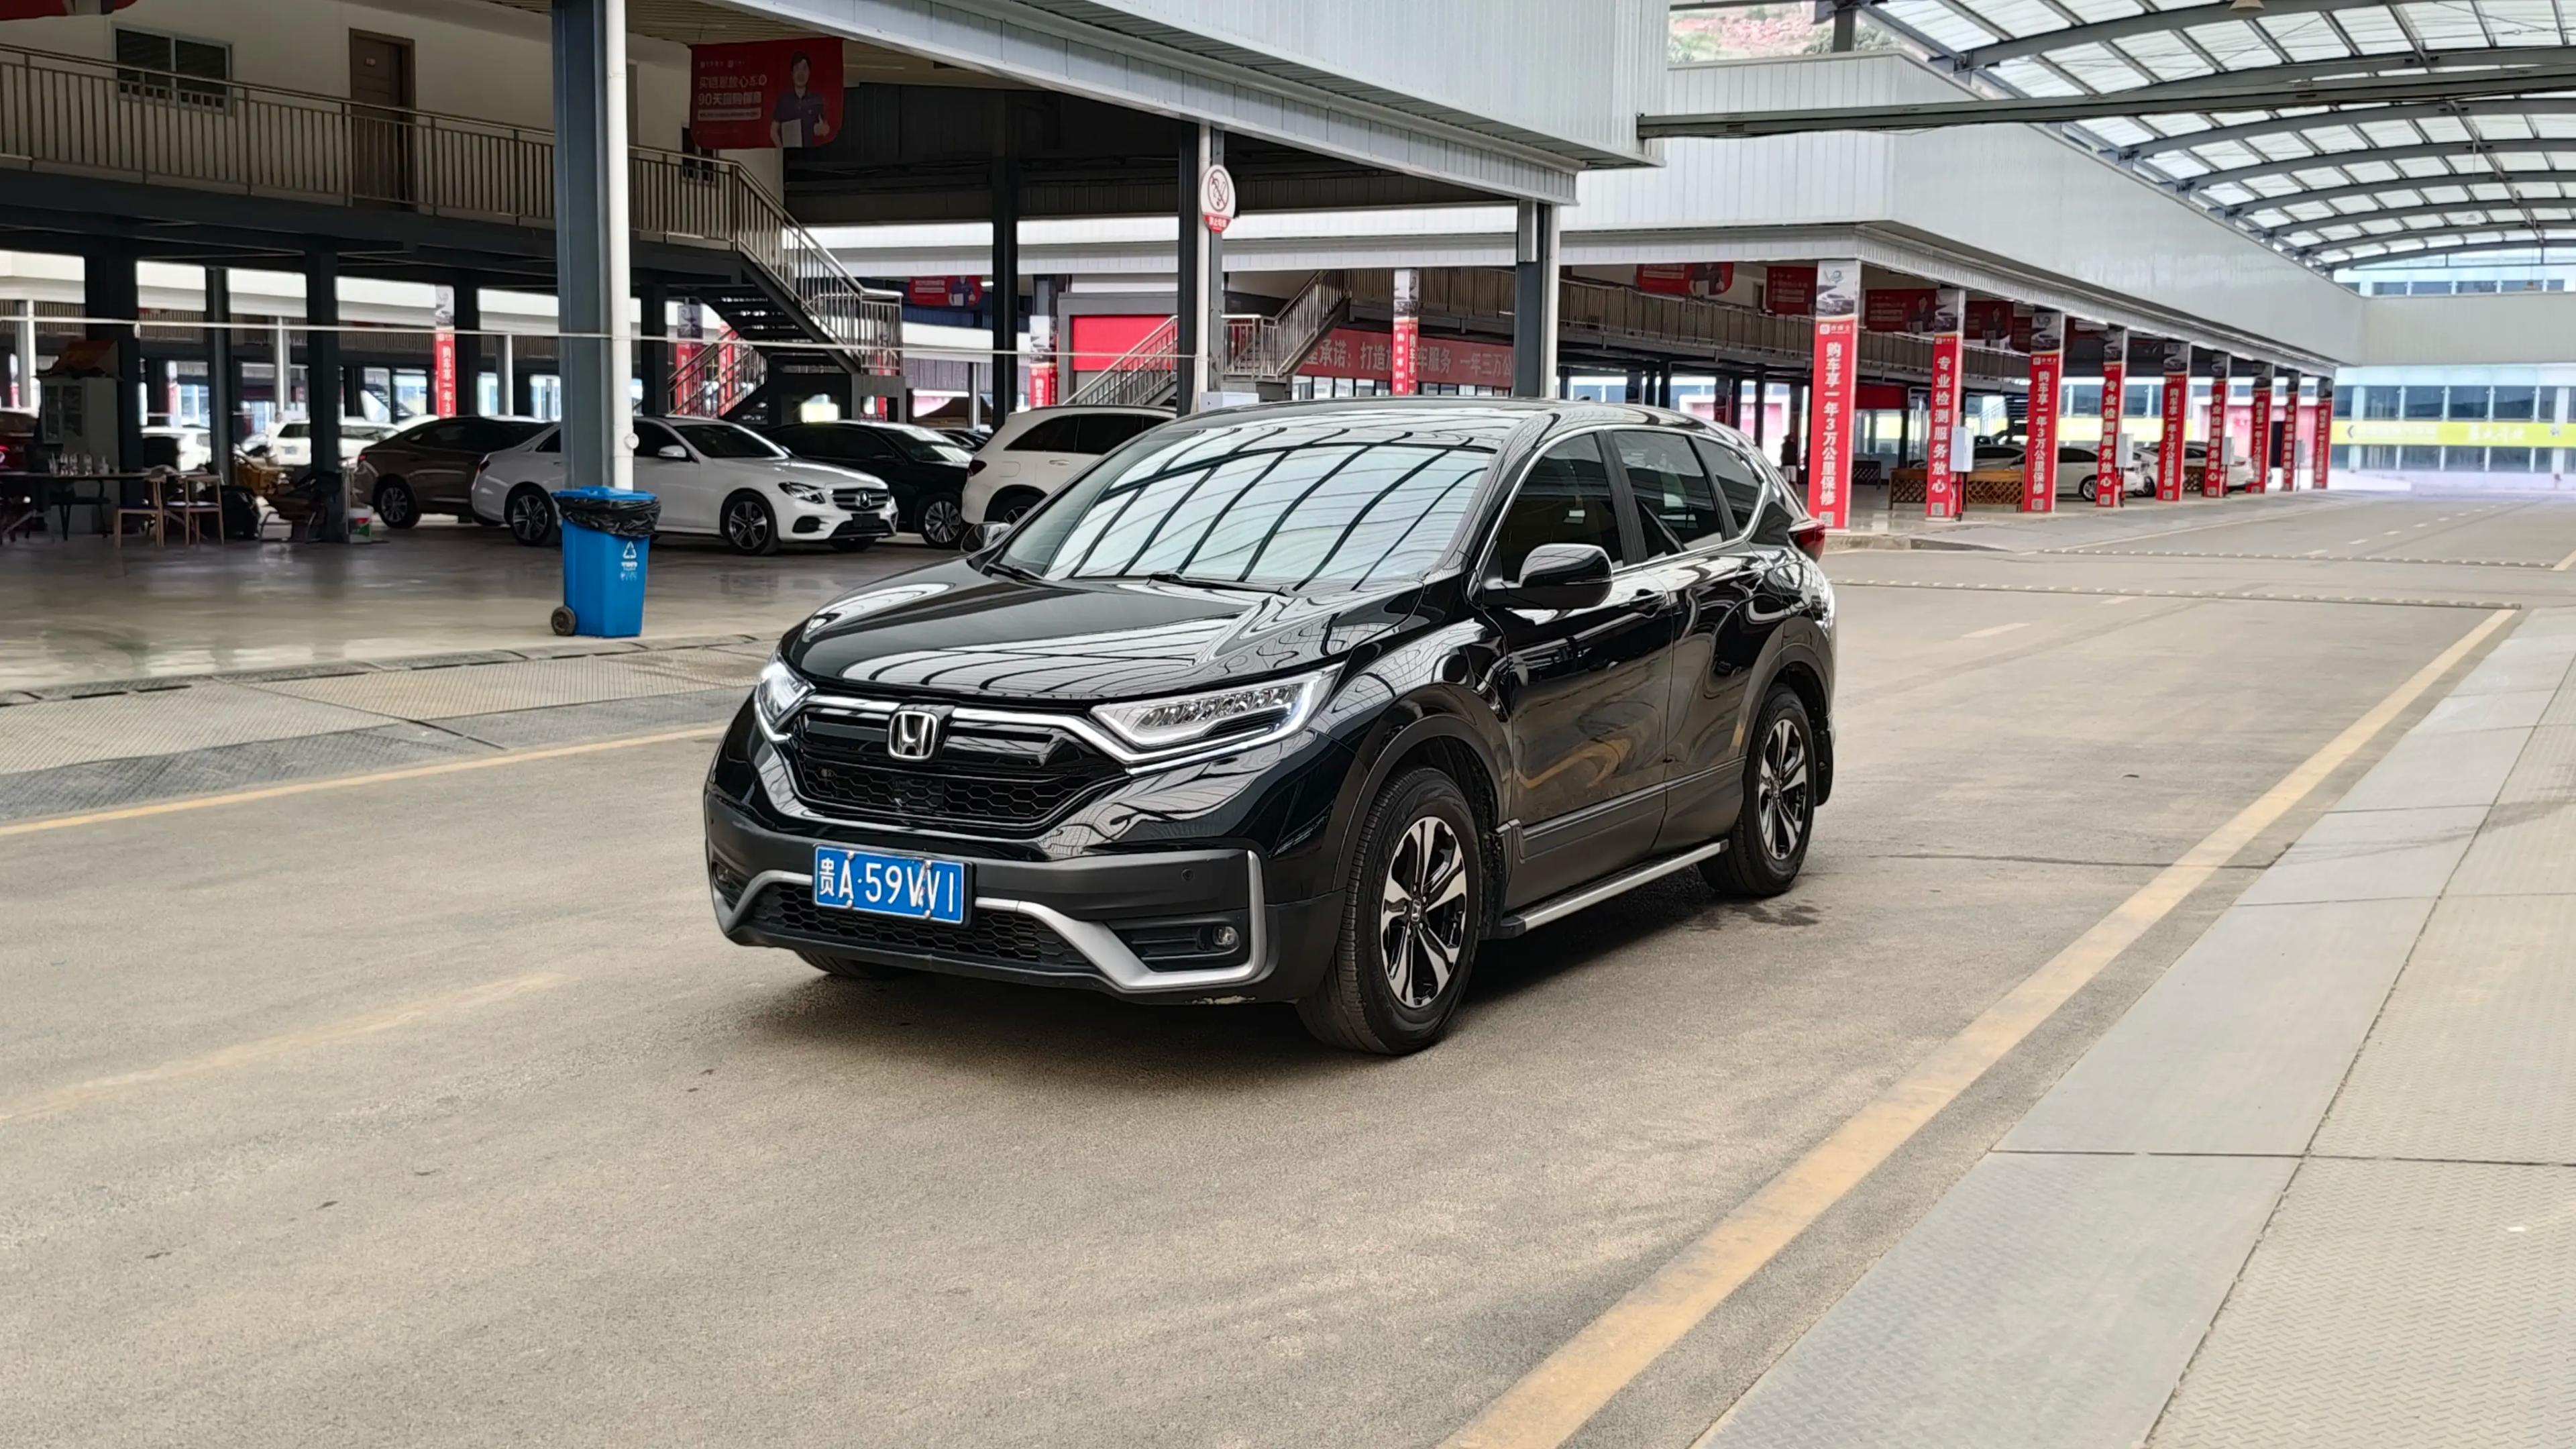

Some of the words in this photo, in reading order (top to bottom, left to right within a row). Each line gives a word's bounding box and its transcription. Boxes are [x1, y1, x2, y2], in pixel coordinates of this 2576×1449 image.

[1819, 342, 1841, 506] 购车享一年3万公里保修
[1931, 356, 1951, 494] 专业检测服务放心
[2033, 370, 2050, 494] 购车享一年3万公里保修
[2100, 380, 2117, 487] 专业检测服务放心
